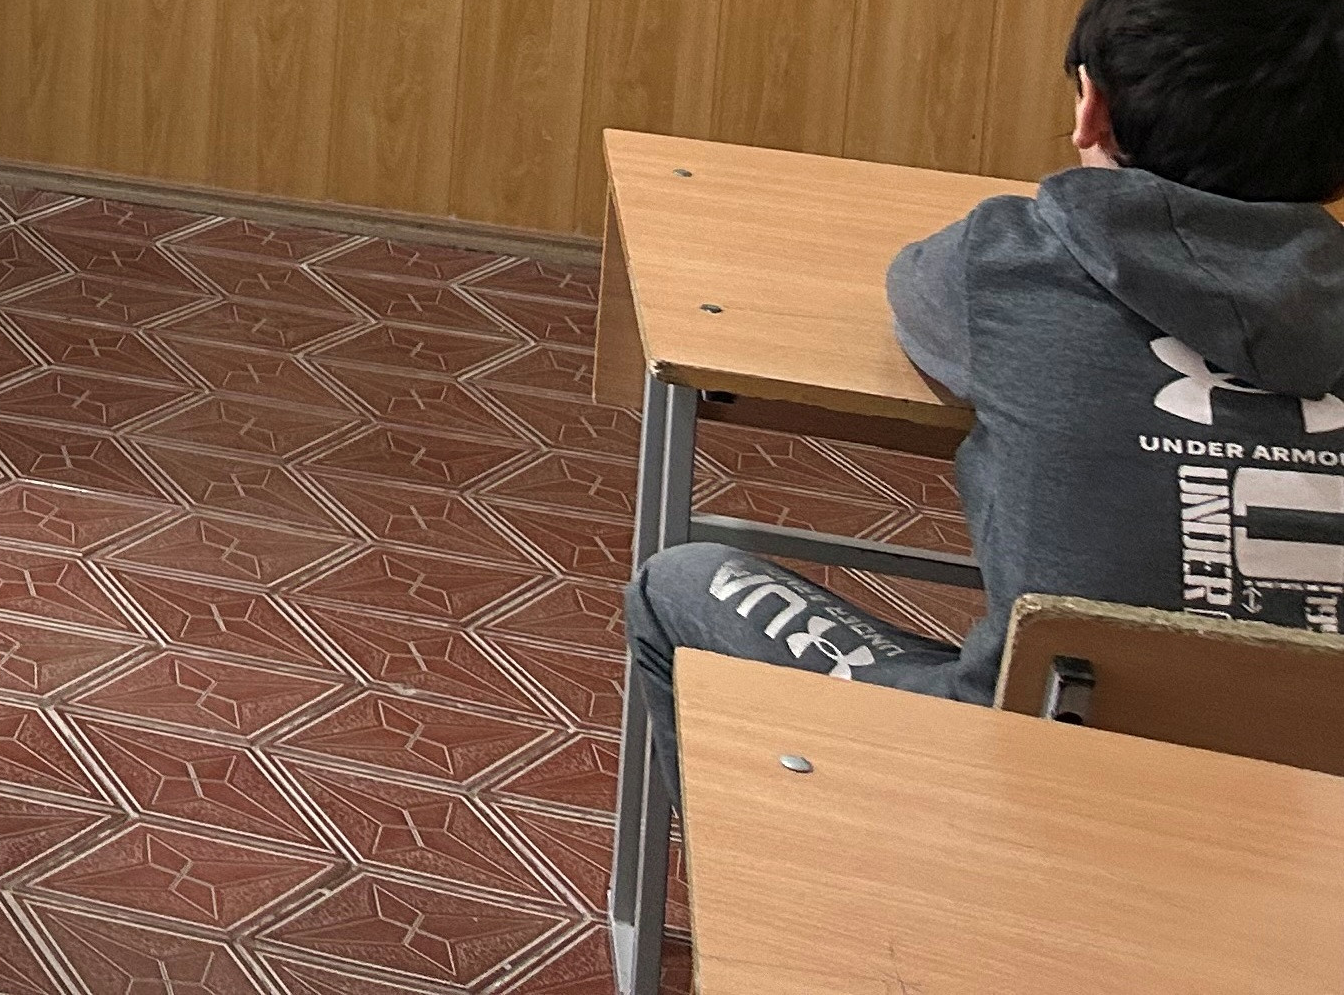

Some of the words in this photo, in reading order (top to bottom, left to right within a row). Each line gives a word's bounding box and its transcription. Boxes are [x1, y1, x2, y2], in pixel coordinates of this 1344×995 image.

[1138, 434, 1244, 459] UNDER
[1252, 445, 1344, 467] ARMO
[1178, 464, 1233, 605] UNDER
[708, 559, 807, 640] UA
